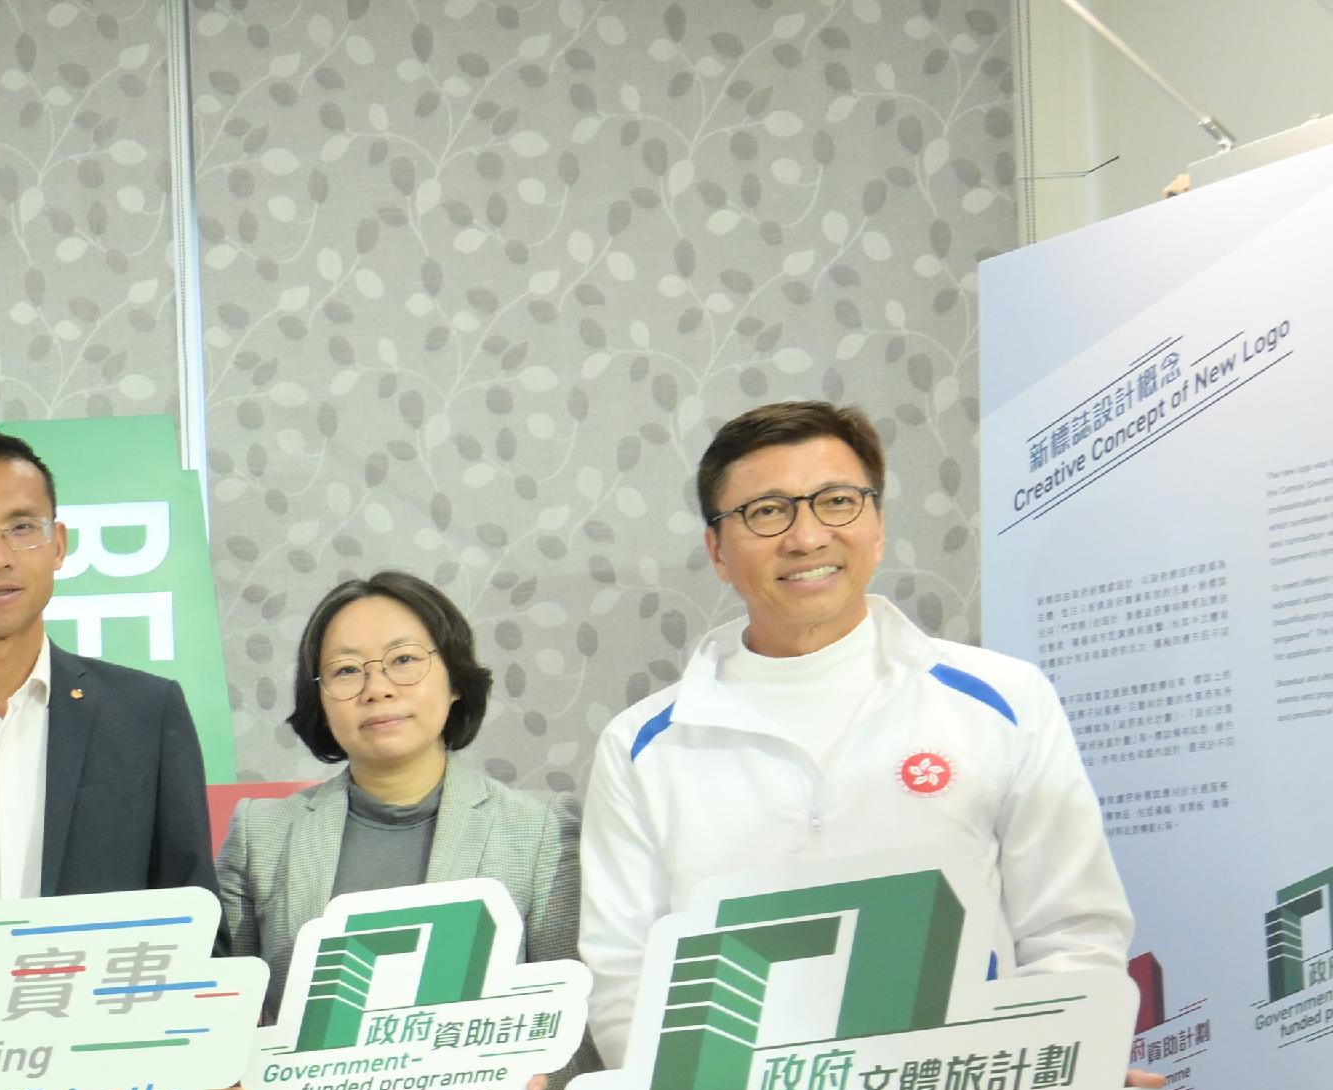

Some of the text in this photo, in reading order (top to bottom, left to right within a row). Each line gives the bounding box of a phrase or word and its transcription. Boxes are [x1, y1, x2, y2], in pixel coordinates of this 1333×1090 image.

[1013, 320, 1290, 512] Creative Concept of New Logo
[364, 1010, 562, 1050] 政府資助計劃
[1130, 1019, 1210, 1064] 府資助計劃
[1280, 1009, 1322, 1038] funded
[263, 1052, 424, 1083] Government-
